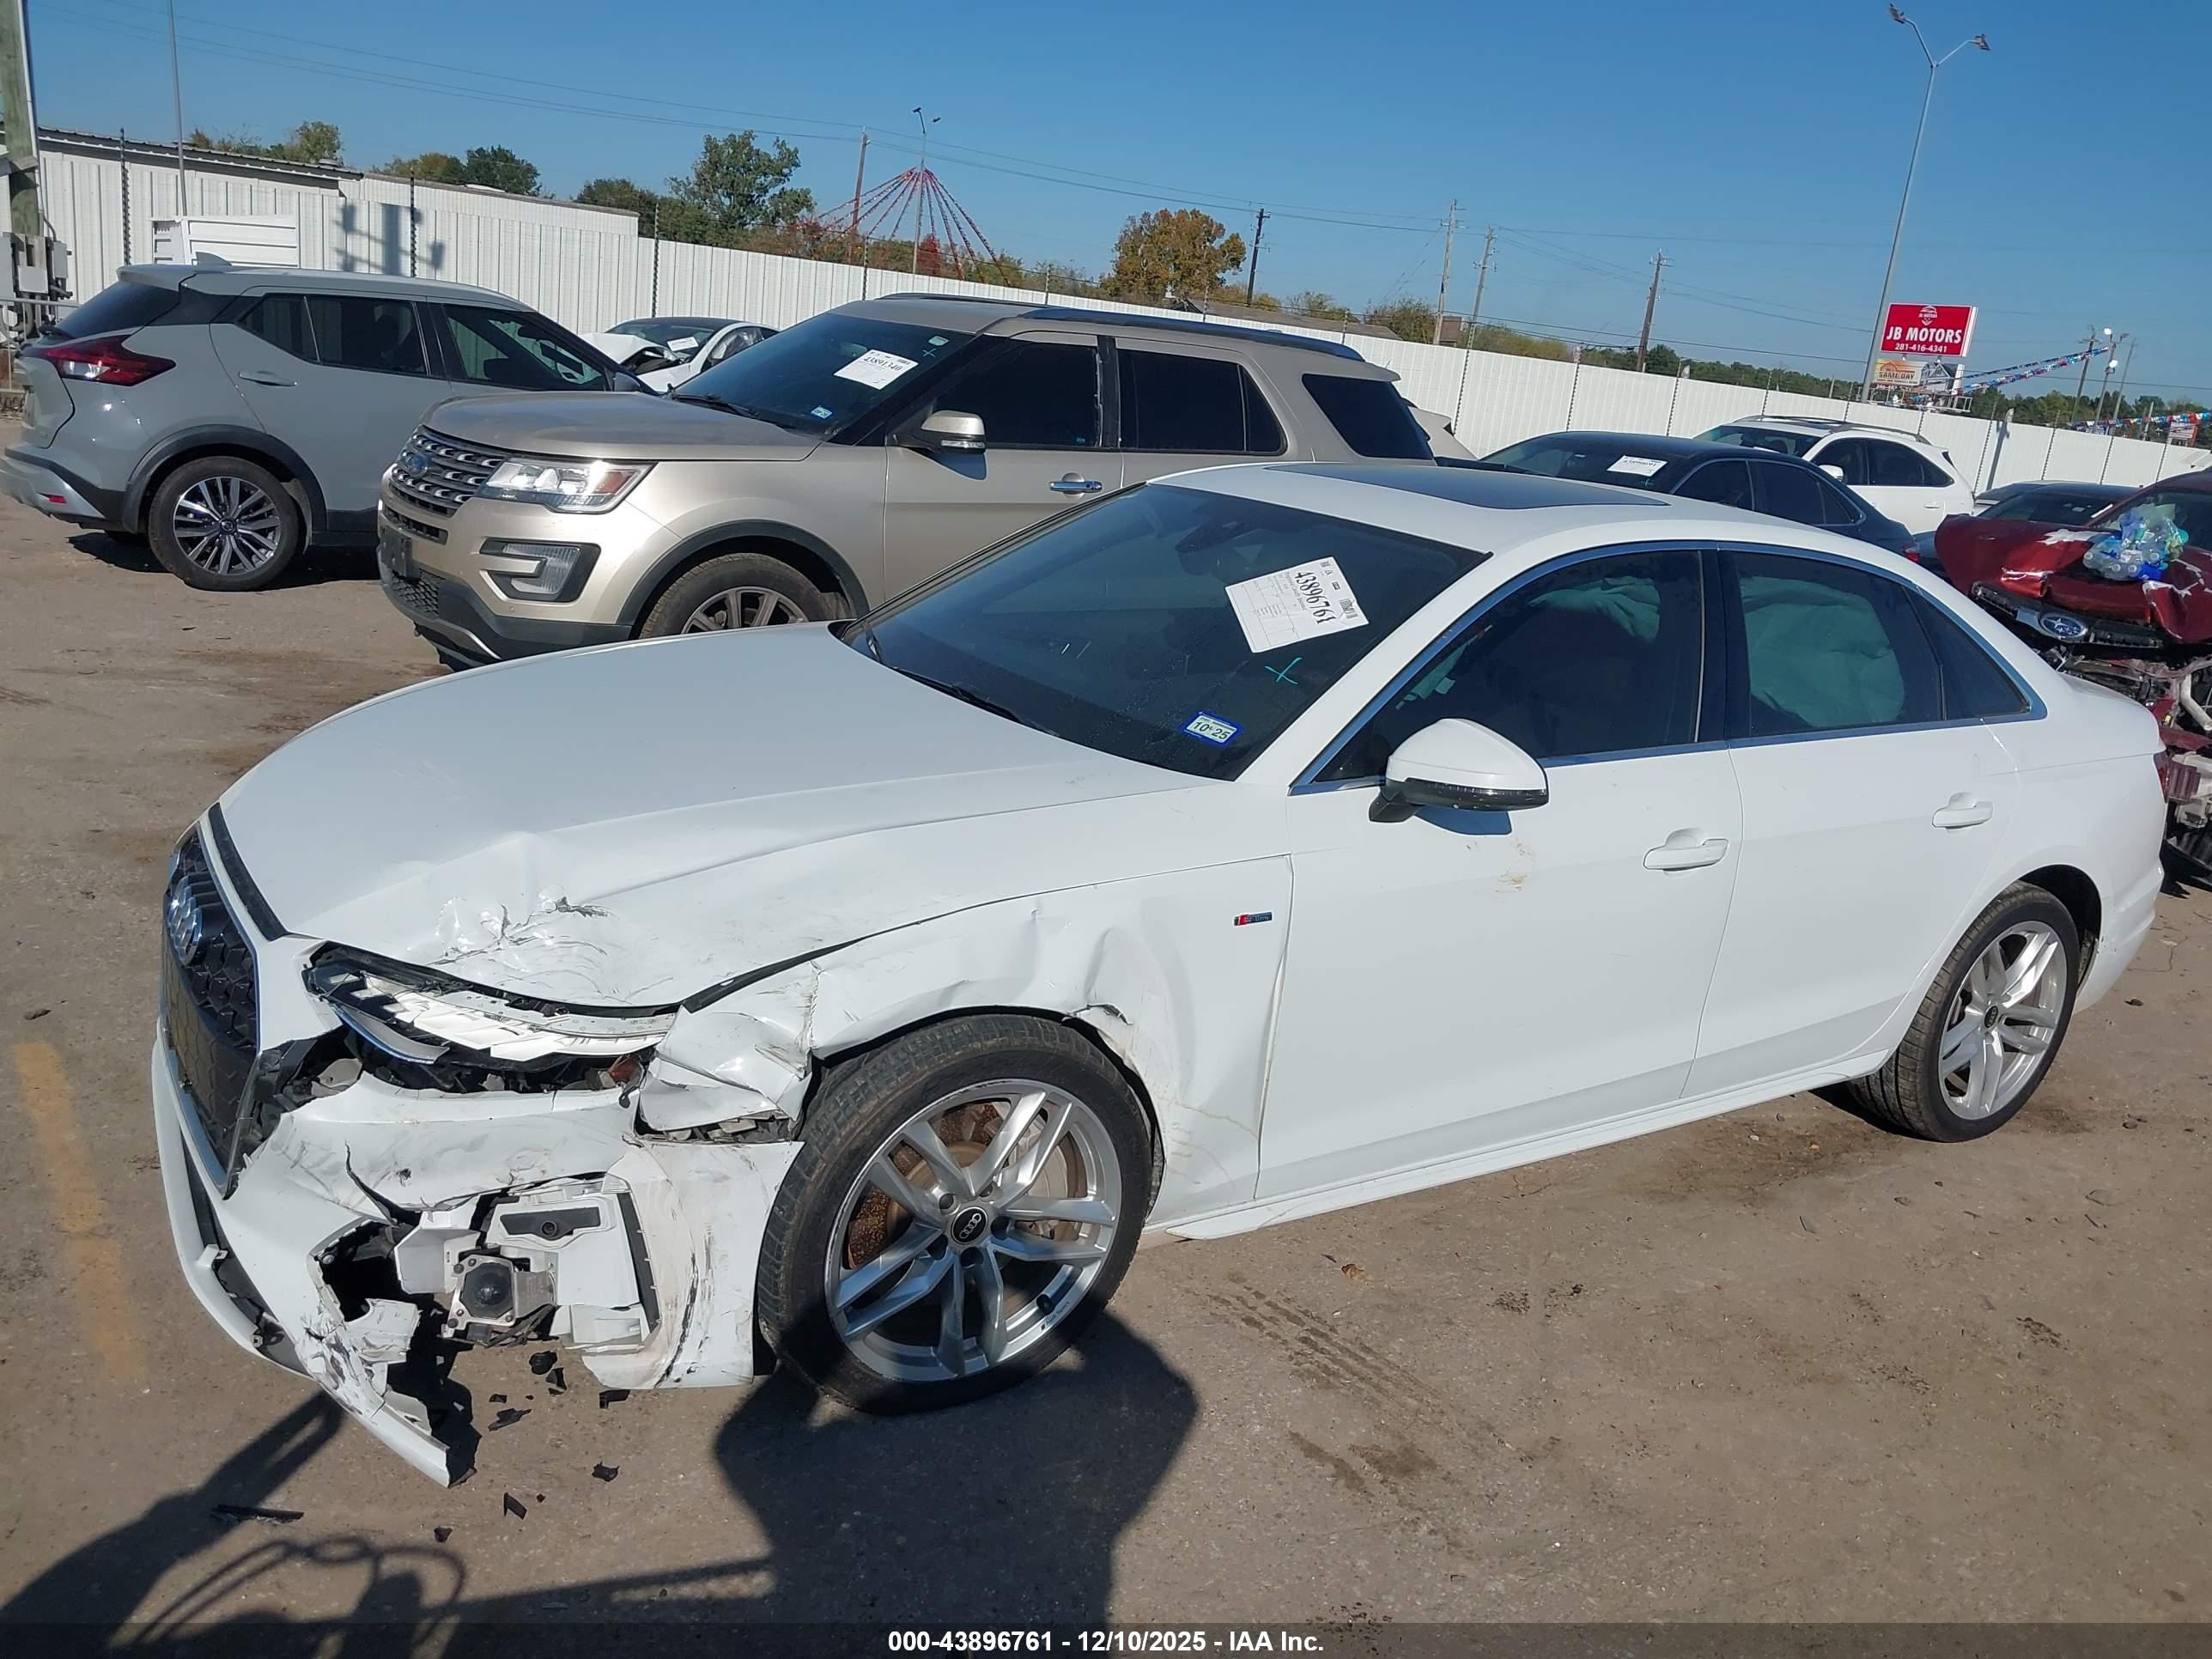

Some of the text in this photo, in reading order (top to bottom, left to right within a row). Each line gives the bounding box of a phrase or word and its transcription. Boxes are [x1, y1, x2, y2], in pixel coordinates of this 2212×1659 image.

[1887, 326, 1961, 343] JB MOTORS
[1894, 343, 1948, 352] 281-416-4341
[1293, 570, 1337, 625] 43896761
[1194, 721, 1210, 732] 10
[1212, 728, 1231, 739] 25
